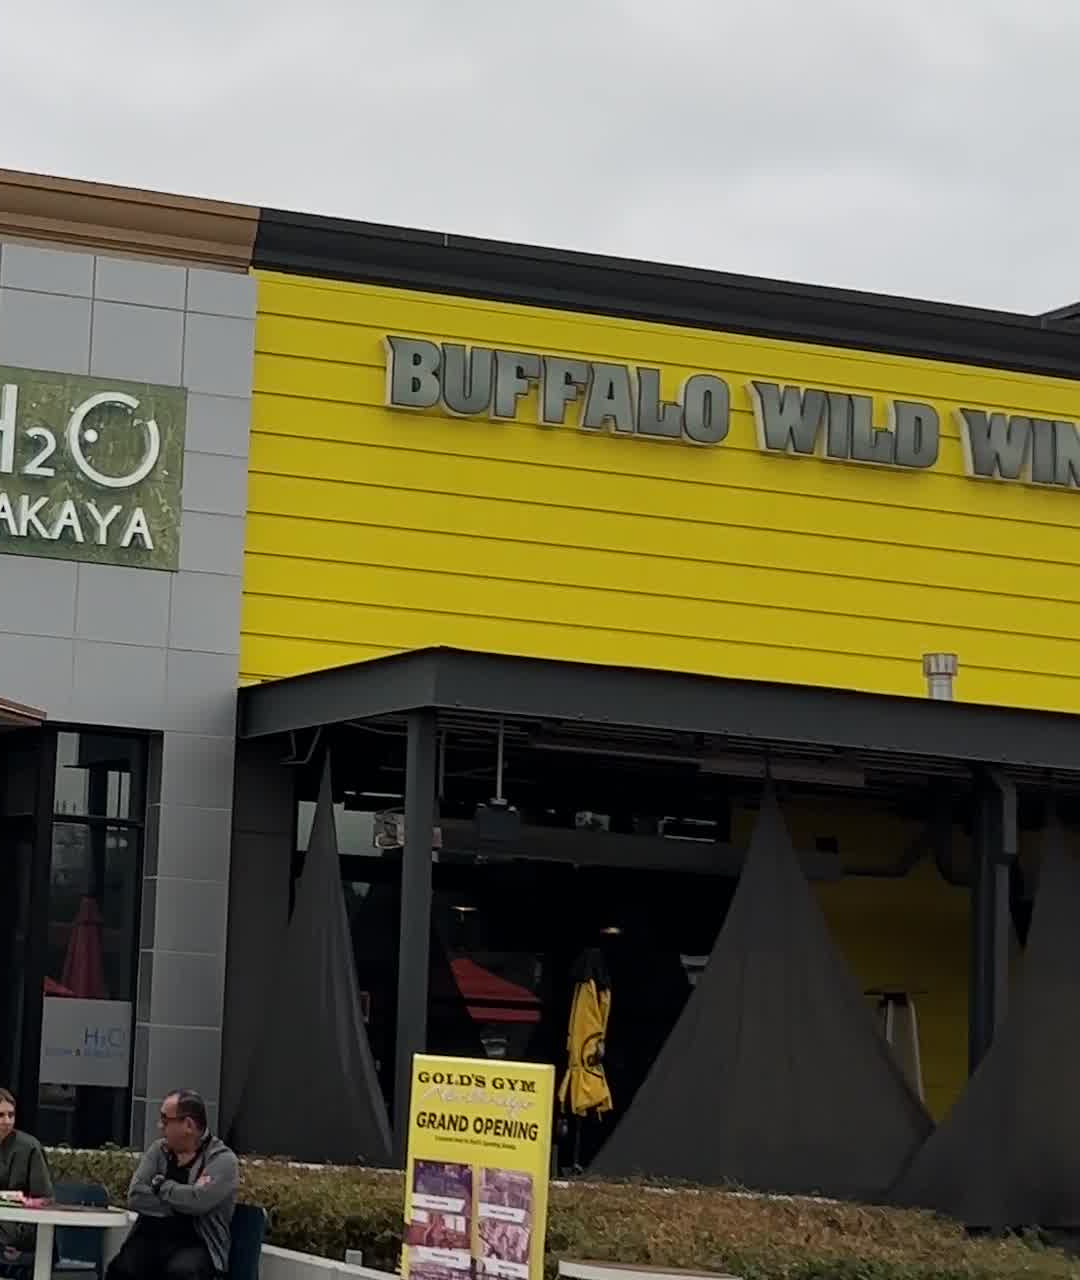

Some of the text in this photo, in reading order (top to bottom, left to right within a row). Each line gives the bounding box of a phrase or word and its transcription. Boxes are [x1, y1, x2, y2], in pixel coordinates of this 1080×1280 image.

[384, 334, 1080, 490] BUFFALO WILD WIN
[418, 1071, 536, 1094] GOLD'S GYM
[416, 1111, 539, 1141] GRAND OPENING
